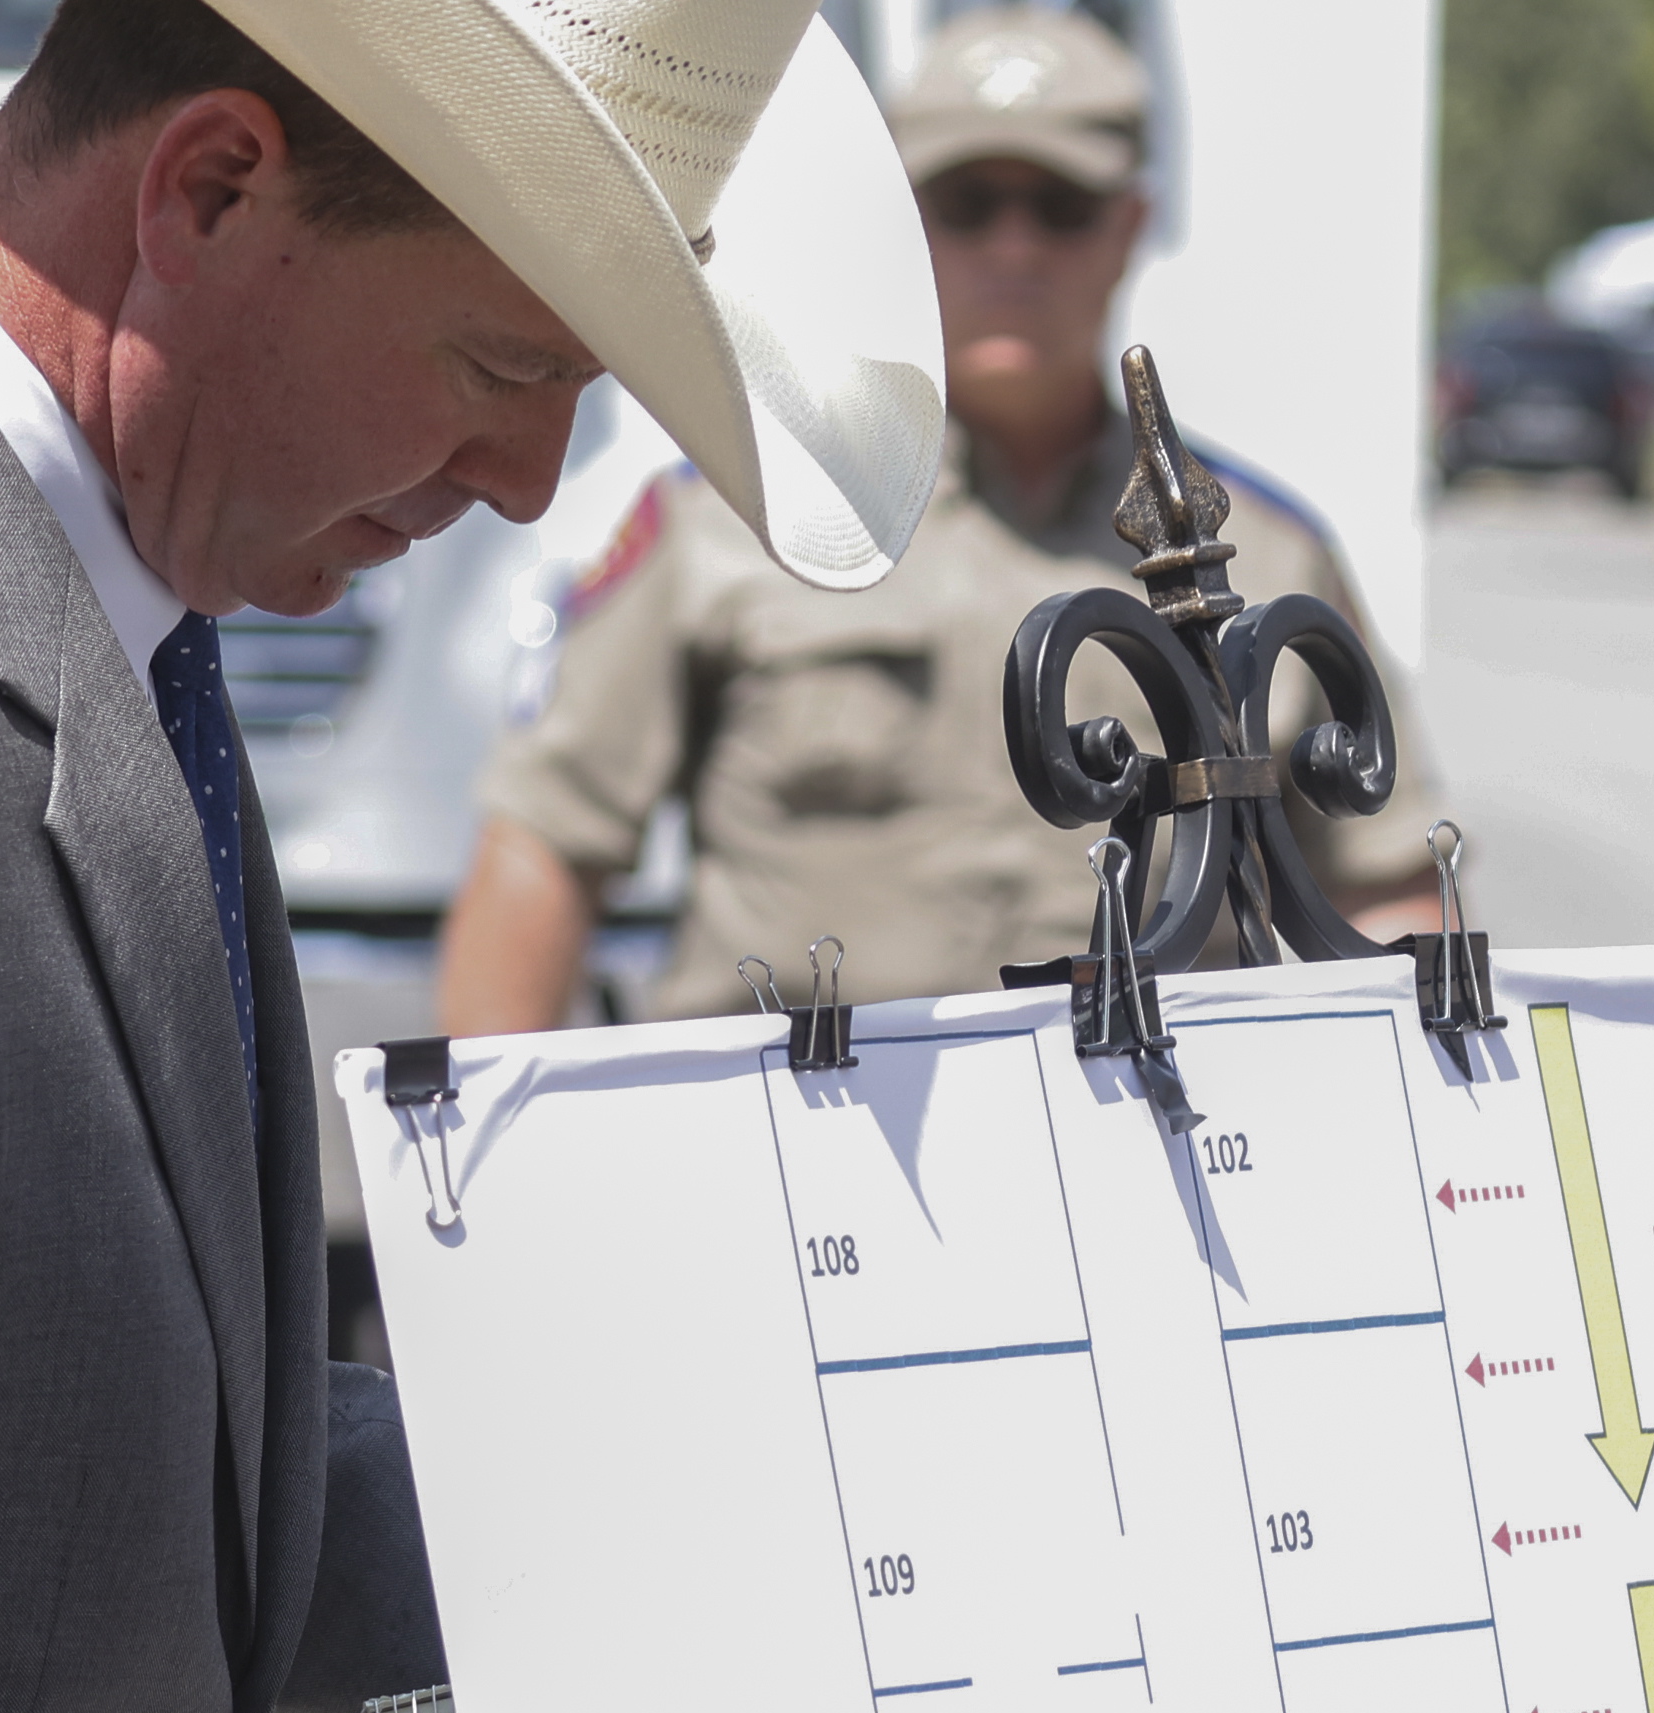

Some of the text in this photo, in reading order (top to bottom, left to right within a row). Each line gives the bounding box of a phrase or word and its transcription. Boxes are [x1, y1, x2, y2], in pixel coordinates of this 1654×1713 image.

[1201, 1131, 1254, 1176] 102
[805, 1233, 861, 1279] 108
[1265, 1508, 1315, 1555] 103
[862, 1552, 916, 1599] 109
